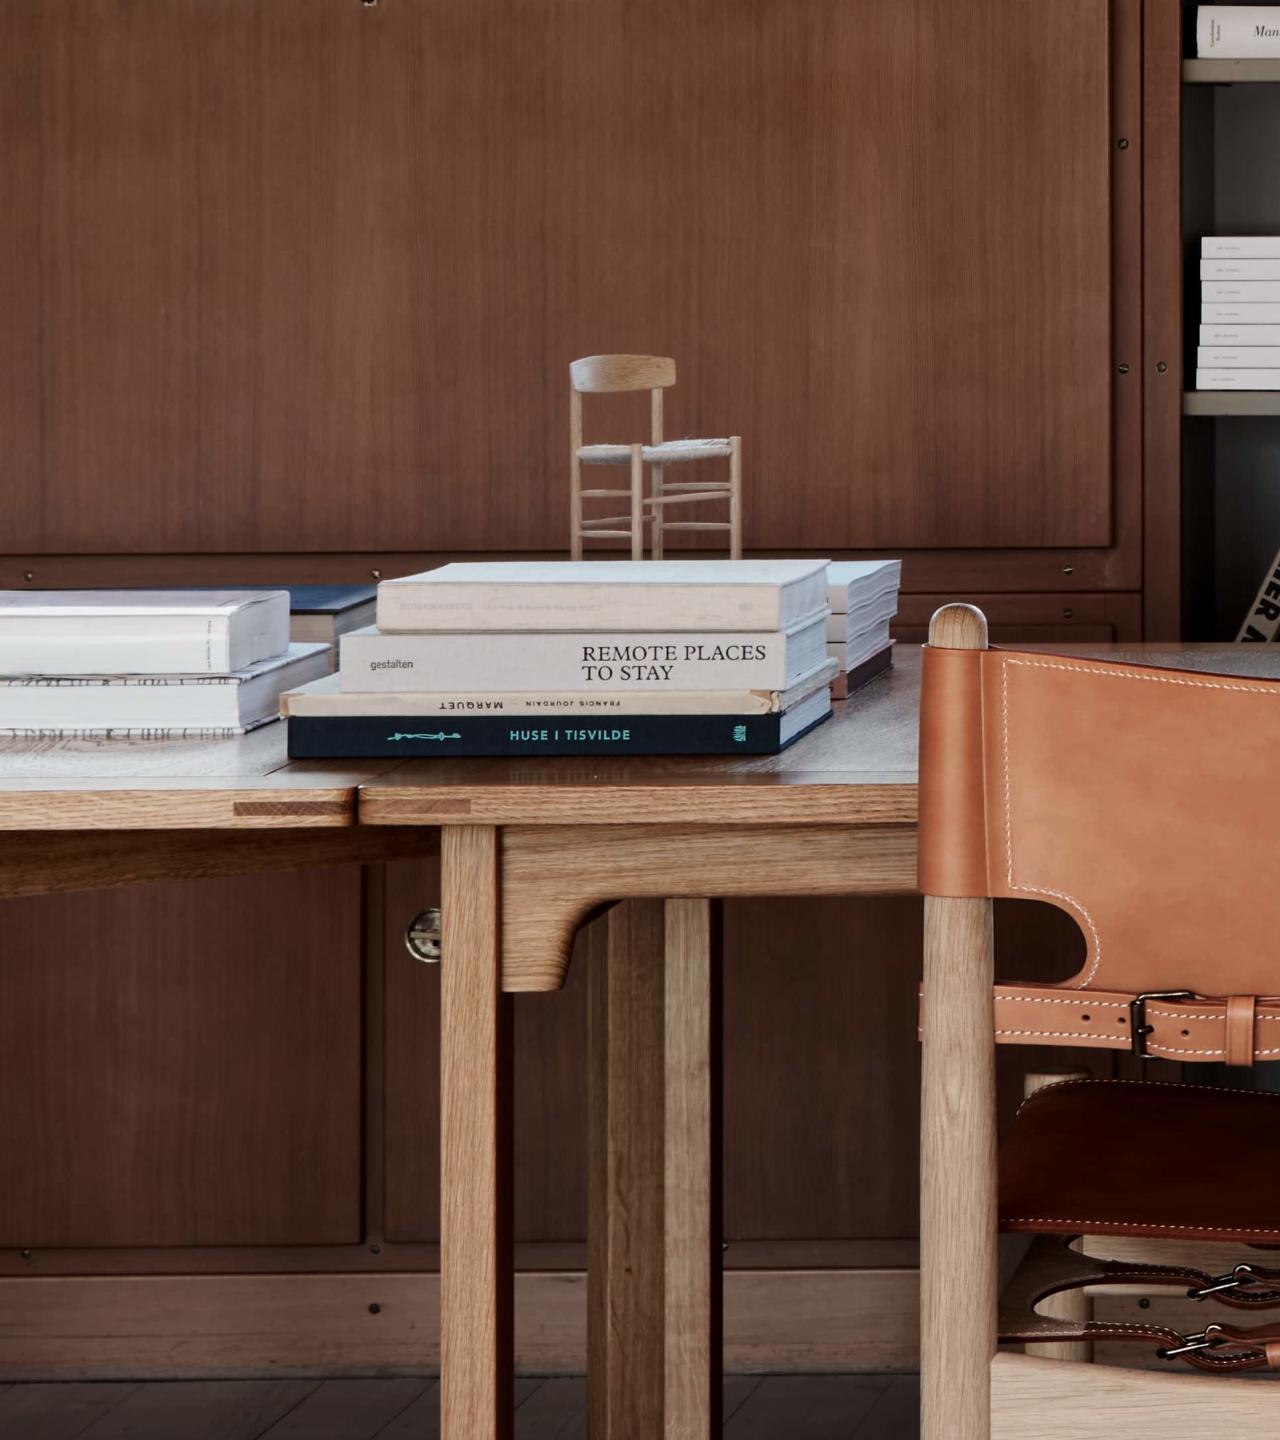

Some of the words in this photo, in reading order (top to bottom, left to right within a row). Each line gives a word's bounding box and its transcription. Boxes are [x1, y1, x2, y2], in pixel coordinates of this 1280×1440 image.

[581, 645, 678, 662] REMOTE
[684, 644, 767, 661] PLACES
[370, 659, 414, 671] gestalten
[581, 665, 613, 681] TO
[620, 665, 675, 681] STAY
[439, 700, 504, 710] MARQUET
[525, 700, 575, 708] JOURDAIN
[509, 729, 549, 741] HUSE
[554, 729, 559, 741] I
[564, 729, 631, 741] TISVILDE
